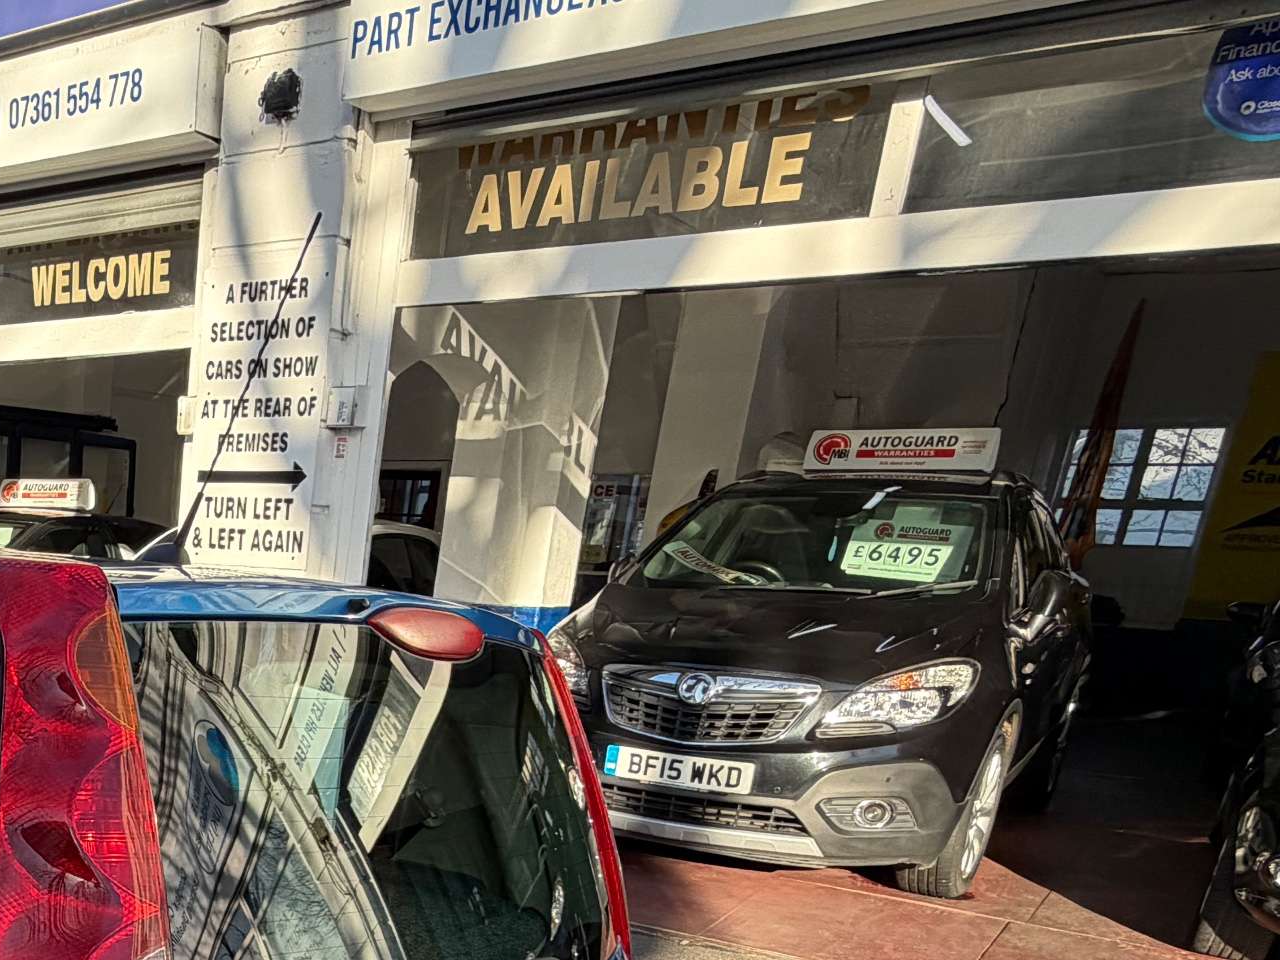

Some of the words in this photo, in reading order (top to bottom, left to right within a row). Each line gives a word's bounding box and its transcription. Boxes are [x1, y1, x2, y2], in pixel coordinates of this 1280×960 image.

[351, 5, 420, 60] PART
[1225, 67, 1254, 83] Ask
[9, 88, 61, 129] 07361
[66, 77, 101, 117] 554
[108, 68, 143, 107] 778
[465, 132, 813, 236] AVAILABLE
[32, 250, 172, 307] WELCOME
[226, 283, 235, 304] A
[240, 277, 309, 303] FURTHER
[211, 318, 291, 342] SELECTION
[295, 316, 316, 337] OF
[206, 358, 243, 380] CARS
[247, 358, 268, 378] ON
[272, 355, 319, 378] SHOW
[201, 399, 218, 419] AT
[223, 398, 249, 418] THE
[254, 396, 292, 418] REAR
[297, 396, 317, 417] OF
[218, 431, 289, 453] PREMISES
[858, 435, 959, 448] AUTOGUARD
[23, 483, 69, 491] AUTOGUARD
[205, 496, 247, 519] TURN
[253, 498, 294, 520] LEFT
[192, 527, 202, 548] &
[209, 527, 246, 550] LEFT
[251, 529, 304, 553] AGAIN
[899, 526, 952, 537] AUTOGUARD
[628, 753, 684, 780] BF15
[690, 761, 742, 788] WKD
